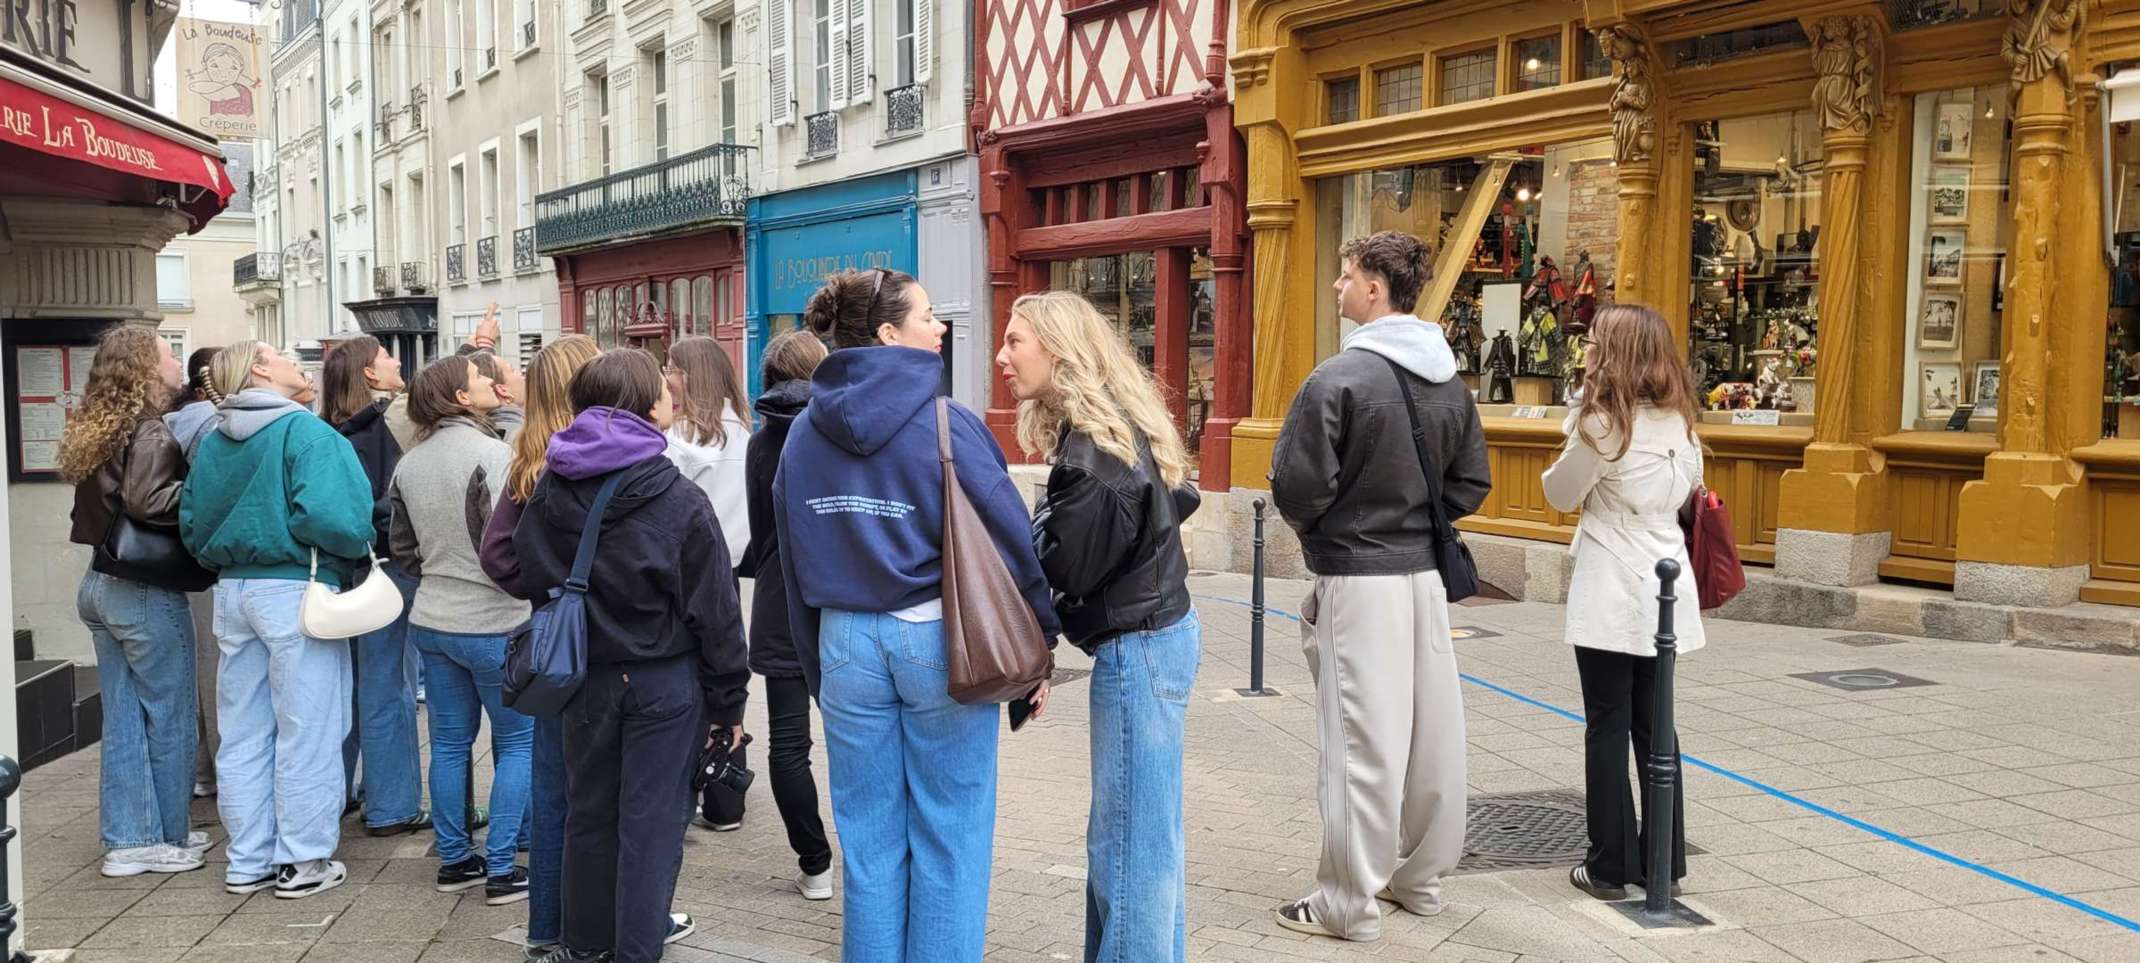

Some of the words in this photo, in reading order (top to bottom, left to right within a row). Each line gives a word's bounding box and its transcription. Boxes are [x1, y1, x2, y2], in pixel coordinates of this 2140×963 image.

[182, 26, 198, 41] La
[204, 23, 264, 46] Boudeuse
[0, 105, 38, 138] RIE
